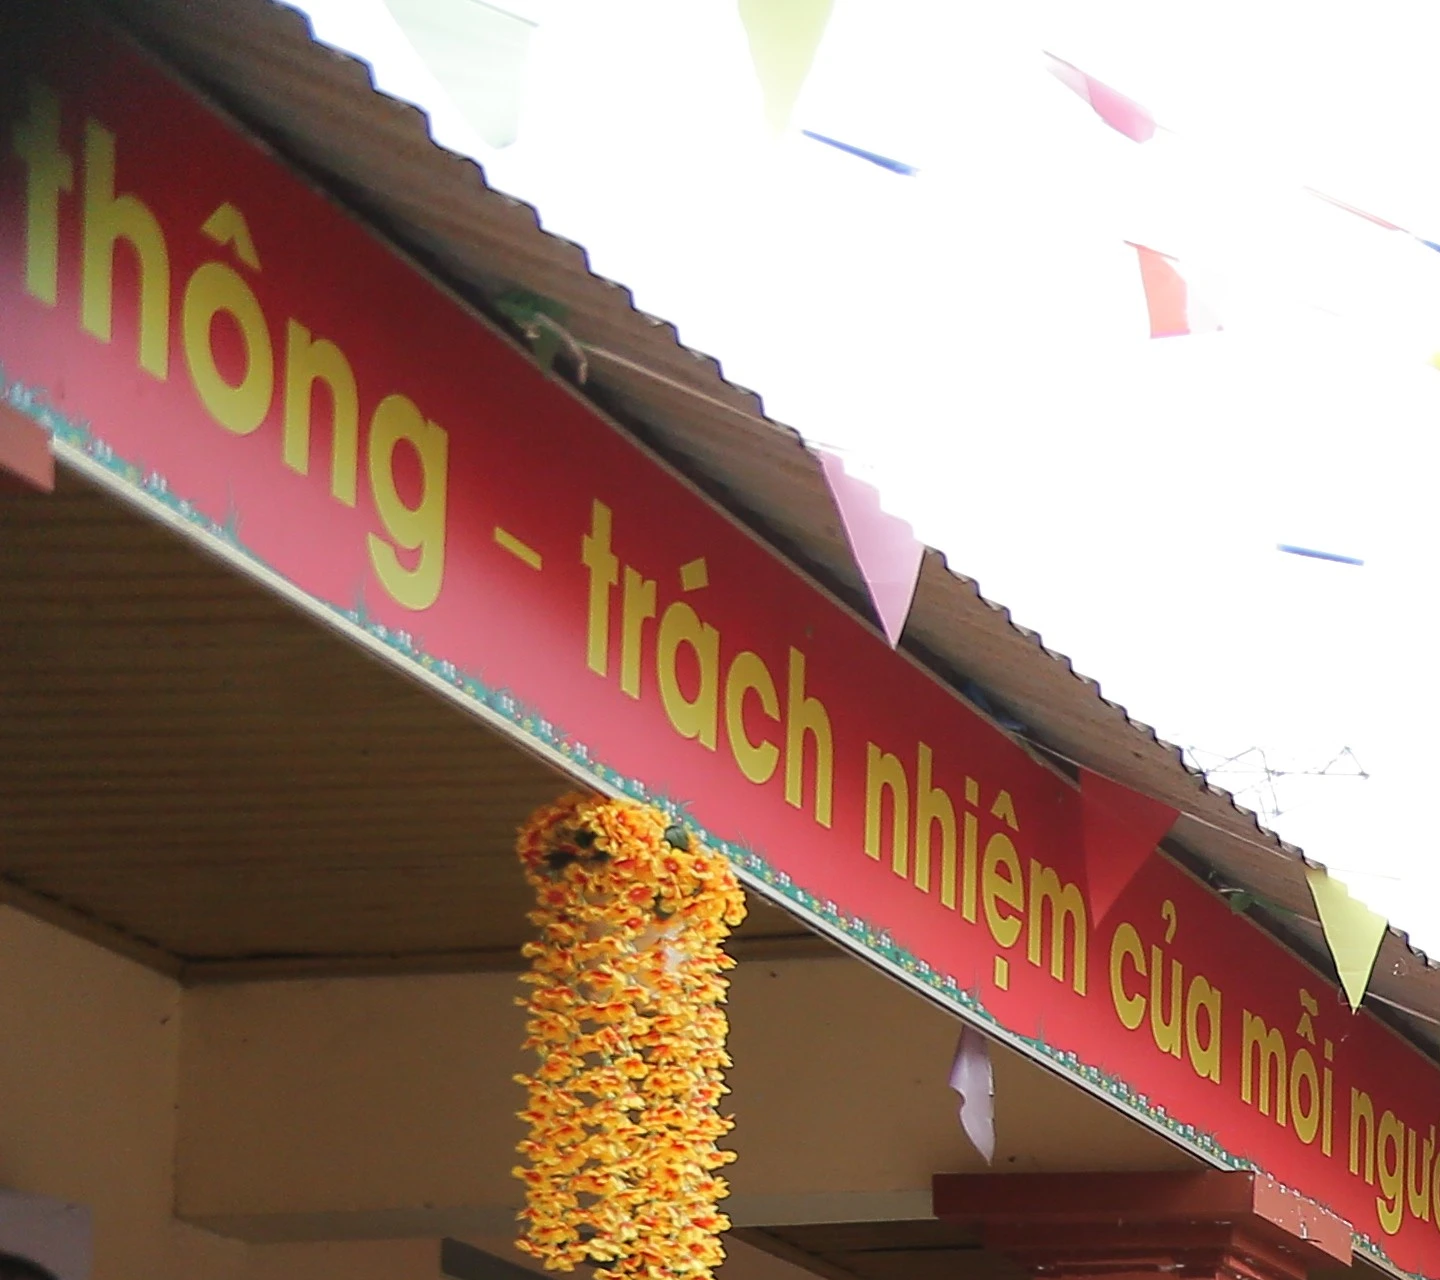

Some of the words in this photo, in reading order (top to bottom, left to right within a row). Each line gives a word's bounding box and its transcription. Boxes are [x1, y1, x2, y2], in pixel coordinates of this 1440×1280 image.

[18, 84, 449, 612] thông
[582, 498, 833, 828] trách
[863, 741, 1088, 997] nhiệm
[1109, 900, 1222, 1085] của
[1240, 989, 1333, 1157] mỗi
